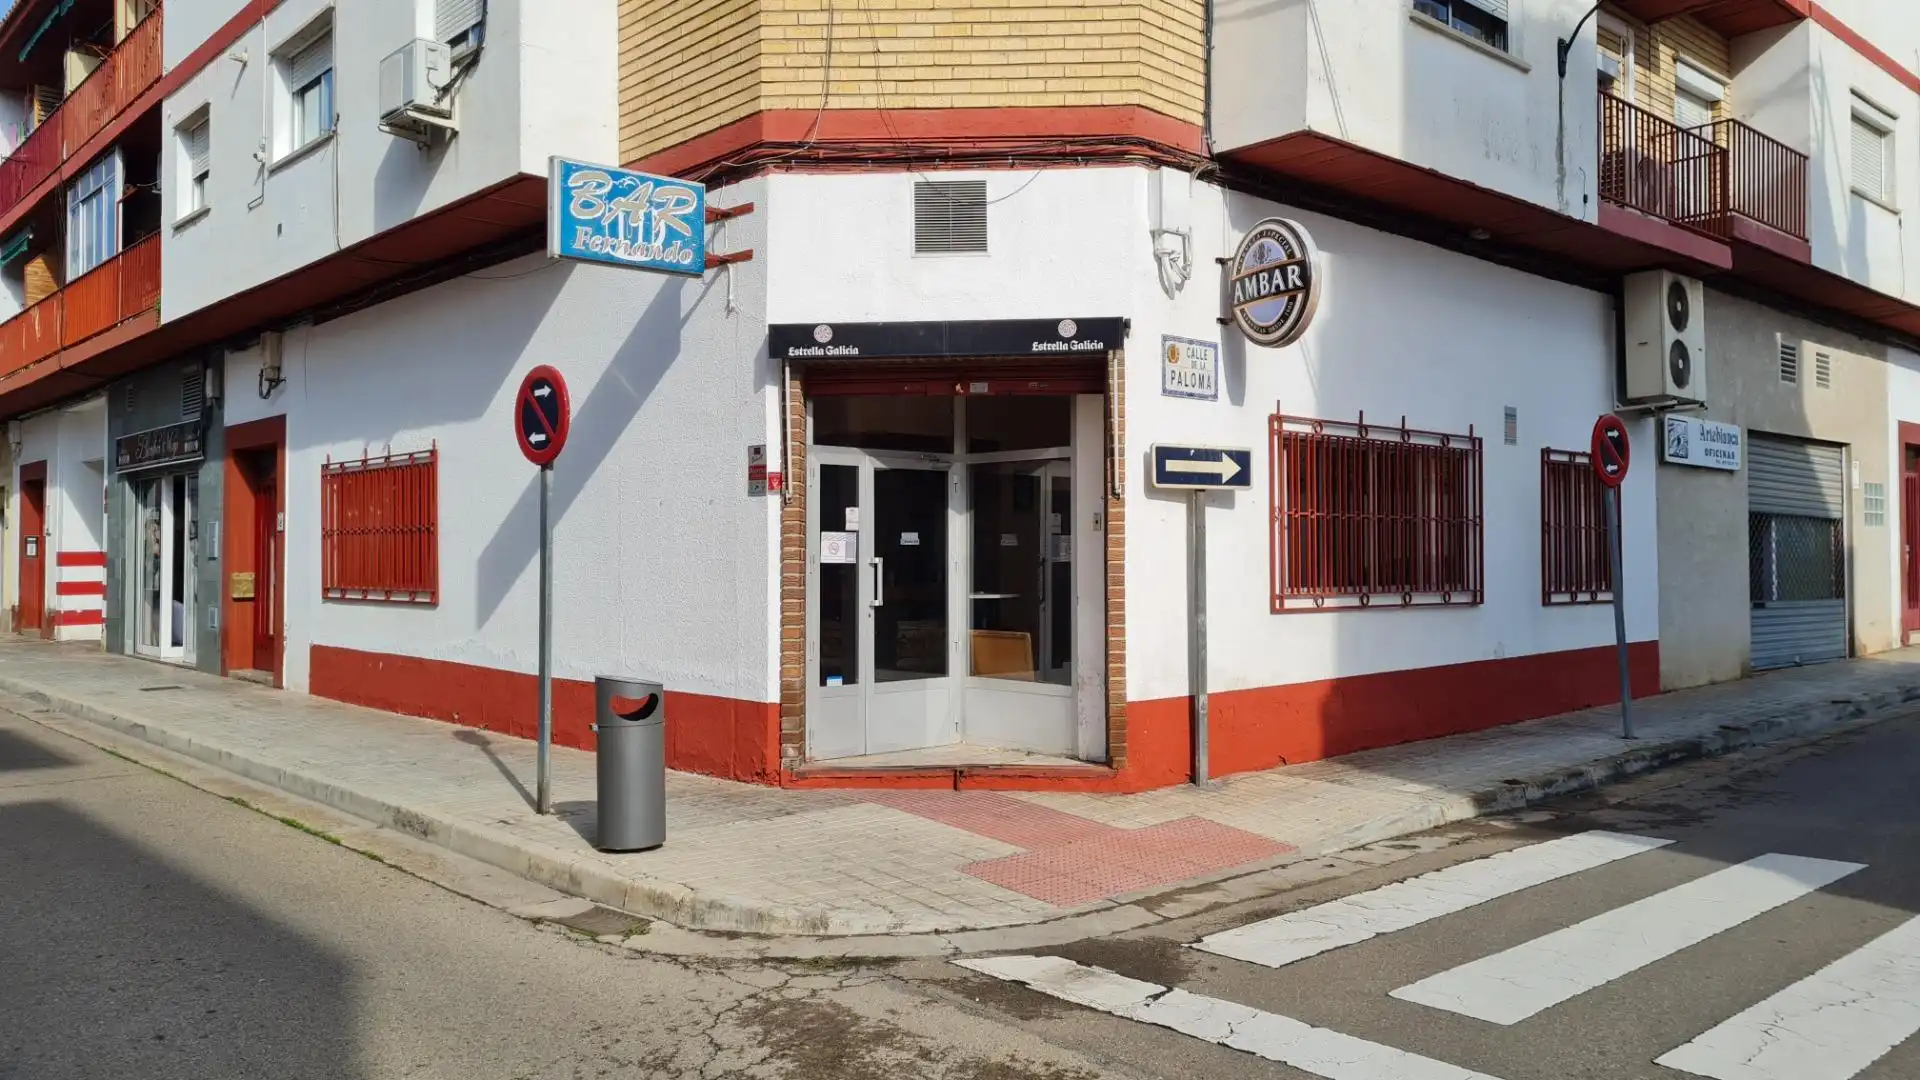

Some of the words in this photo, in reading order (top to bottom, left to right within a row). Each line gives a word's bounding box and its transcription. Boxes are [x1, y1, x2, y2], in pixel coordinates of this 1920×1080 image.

[567, 170, 698, 237] BAR
[573, 225, 694, 264] Fernando
[1233, 264, 1304, 305] AMBAR
[788, 346, 824, 356] Estrella
[825, 345, 859, 355] Galicia
[1032, 341, 1069, 351] Estrella
[1070, 340, 1104, 350] Galicia
[1186, 347, 1208, 361] CALLE
[1170, 370, 1212, 390] PALOMA
[1704, 447, 1735, 460] OFICINAS
